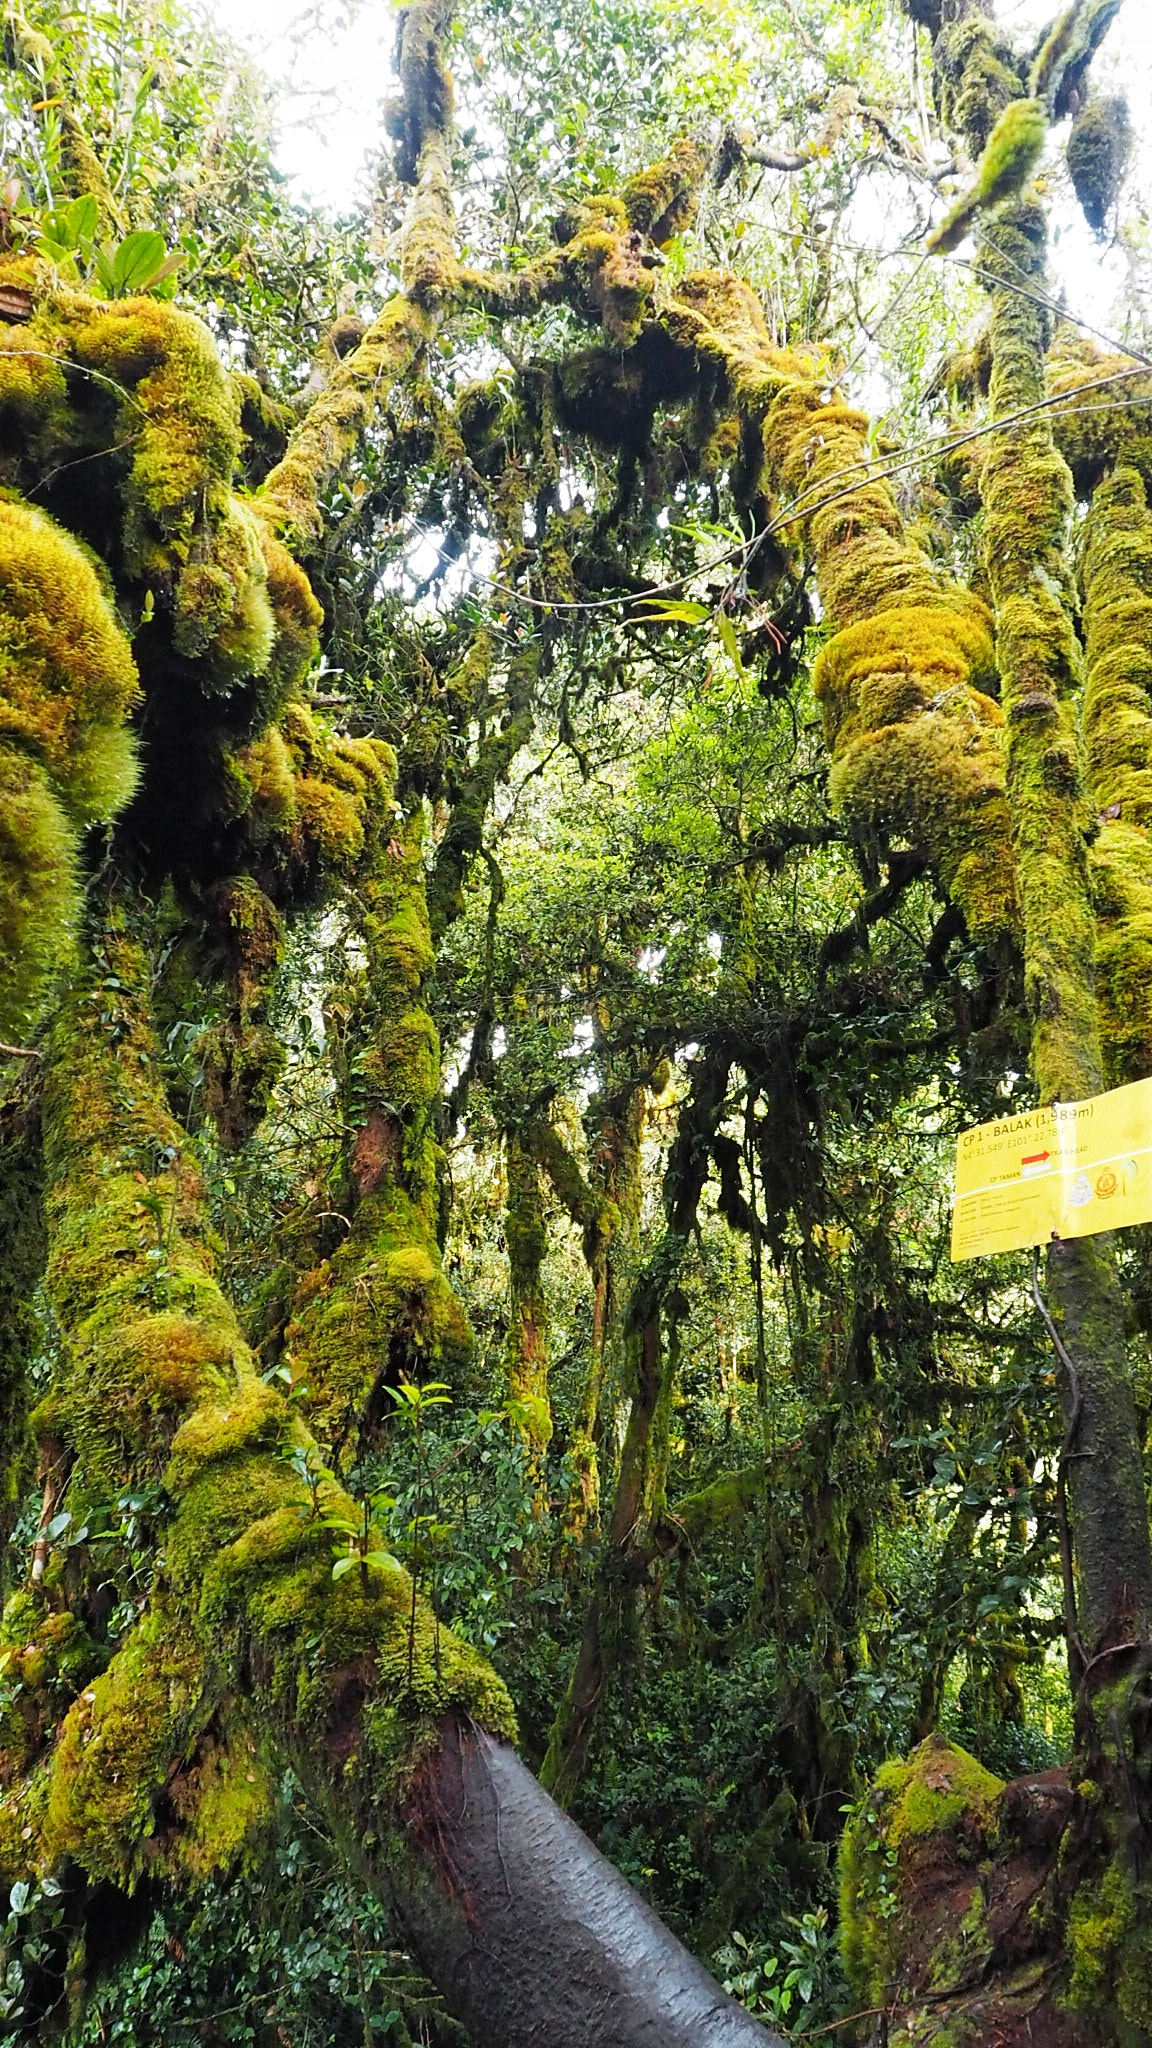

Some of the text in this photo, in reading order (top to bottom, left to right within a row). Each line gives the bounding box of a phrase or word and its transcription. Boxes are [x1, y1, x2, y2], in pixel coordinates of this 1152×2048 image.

[963, 1134, 975, 1147] CP
[977, 1131, 983, 1142] 1
[993, 1117, 1032, 1137] BALAK
[1036, 1103, 1094, 1129] (1,989m)
